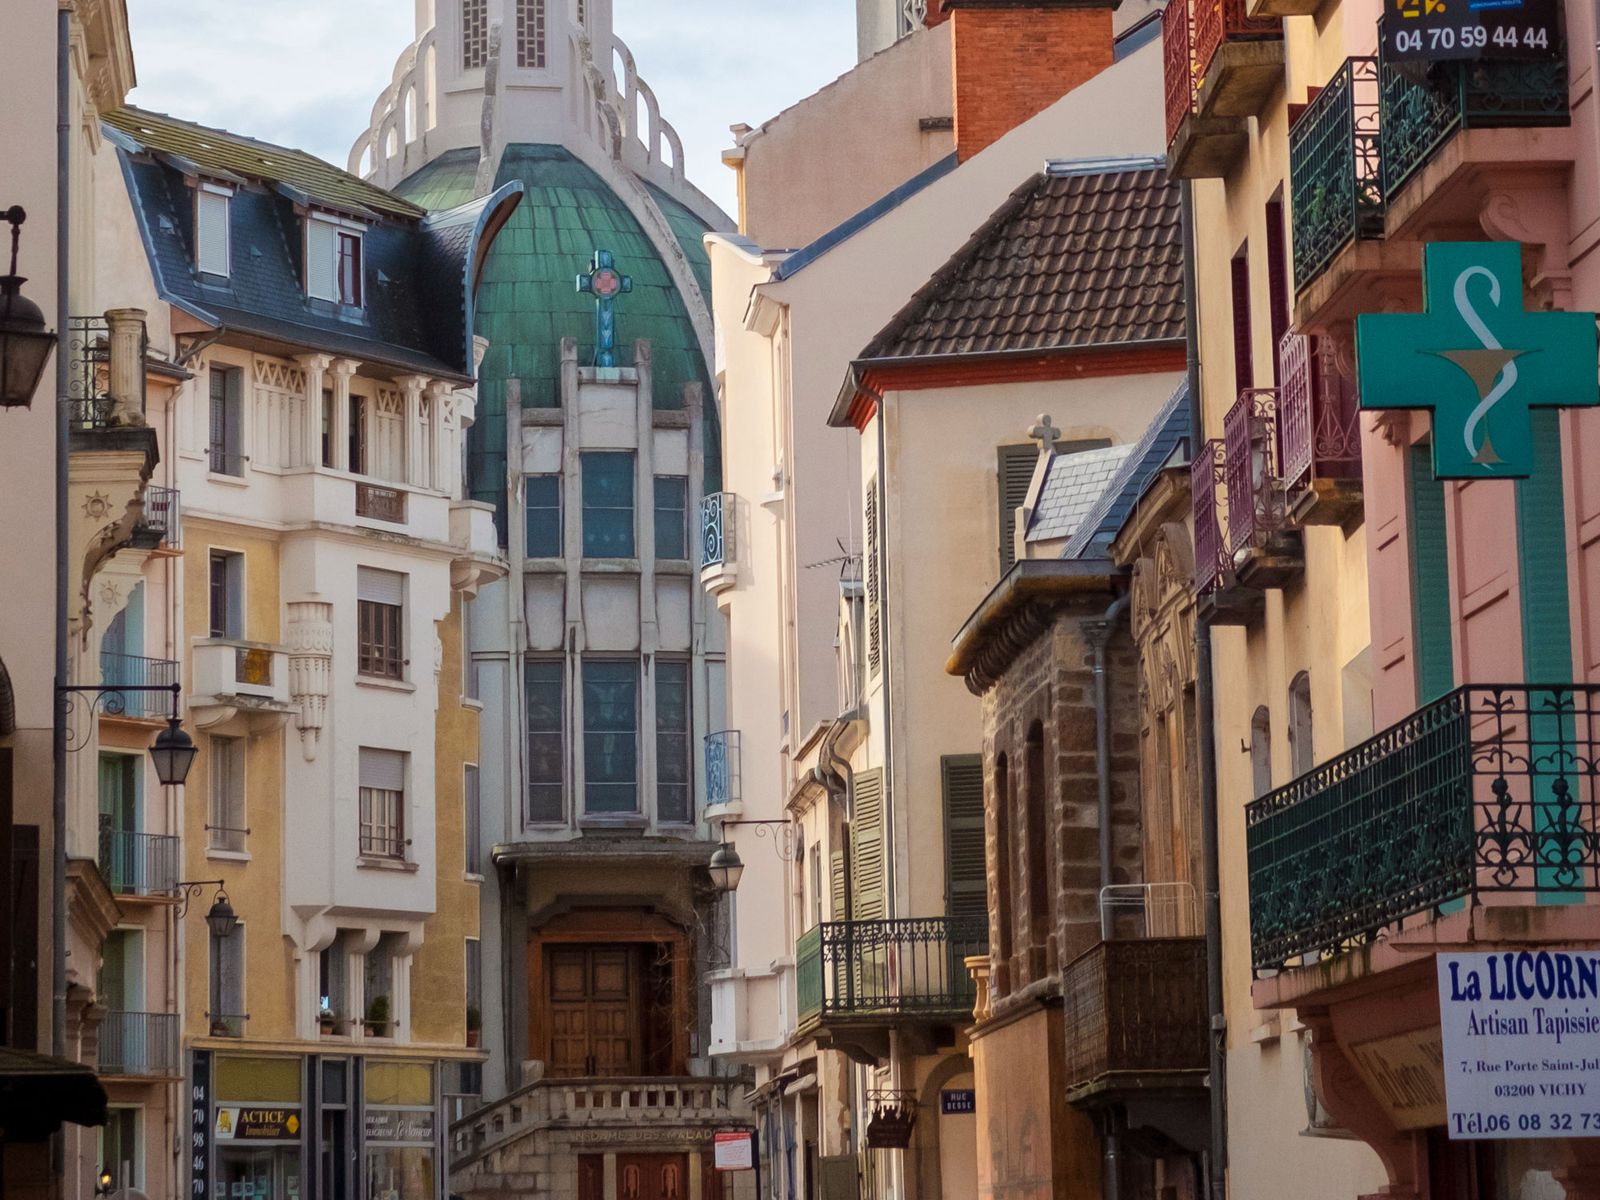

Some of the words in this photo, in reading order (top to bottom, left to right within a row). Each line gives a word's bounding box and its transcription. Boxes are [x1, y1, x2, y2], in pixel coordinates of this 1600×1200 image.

[1395, 29, 1422, 52] 04
[1427, 27, 1455, 50] 70
[1460, 25, 1487, 48] 59
[1492, 26, 1518, 48] 44
[1523, 27, 1548, 49] 44
[1448, 961, 1482, 1001] La
[1487, 950, 1600, 1000] LICORN
[1467, 1008, 1529, 1036] Artisan
[1533, 1007, 1600, 1044] Tapissie
[1460, 1061, 1473, 1074] 7,
[1476, 1060, 1501, 1072] Rue
[1505, 1059, 1538, 1072] Porte
[193, 1086, 204, 1100] 04
[1494, 1084, 1535, 1097] 03200
[1539, 1083, 1587, 1096] VICHY
[193, 1108, 204, 1124] 70
[241, 1110, 285, 1123] ACTICE
[1518, 1113, 1541, 1131] 08
[1550, 1113, 1573, 1130] 32
[193, 1132, 204, 1147] 98
[666, 1128, 714, 1141] MALAD
[193, 1155, 204, 1170] 46
[193, 1179, 204, 1193] 70
